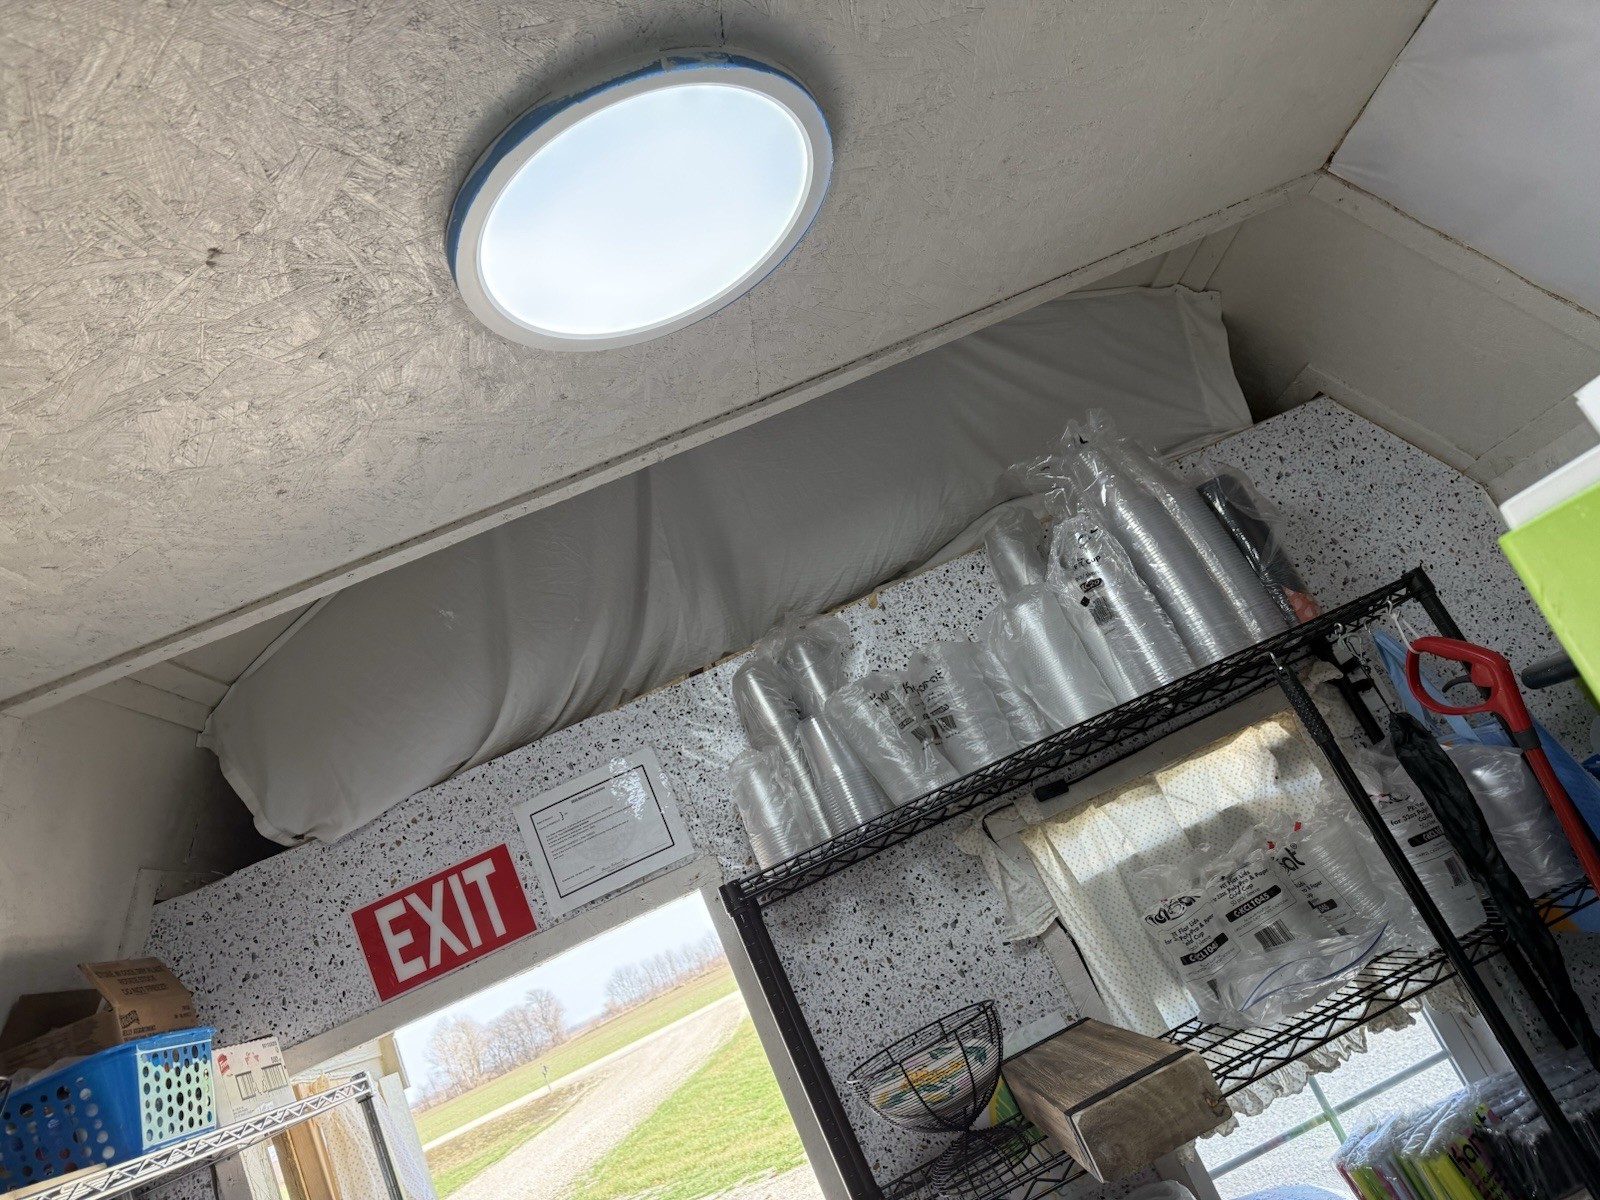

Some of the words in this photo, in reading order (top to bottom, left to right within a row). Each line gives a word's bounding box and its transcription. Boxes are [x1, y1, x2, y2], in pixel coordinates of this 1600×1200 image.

[1228, 890, 1241, 899] Cold
[1241, 883, 1253, 892] Cup
[1232, 892, 1270, 918] C-KCL1045
[373, 858, 507, 983] EXIT
[1177, 924, 1189, 934] Flat
[1188, 917, 1199, 926] Lids
[1192, 931, 1205, 941] Cup
